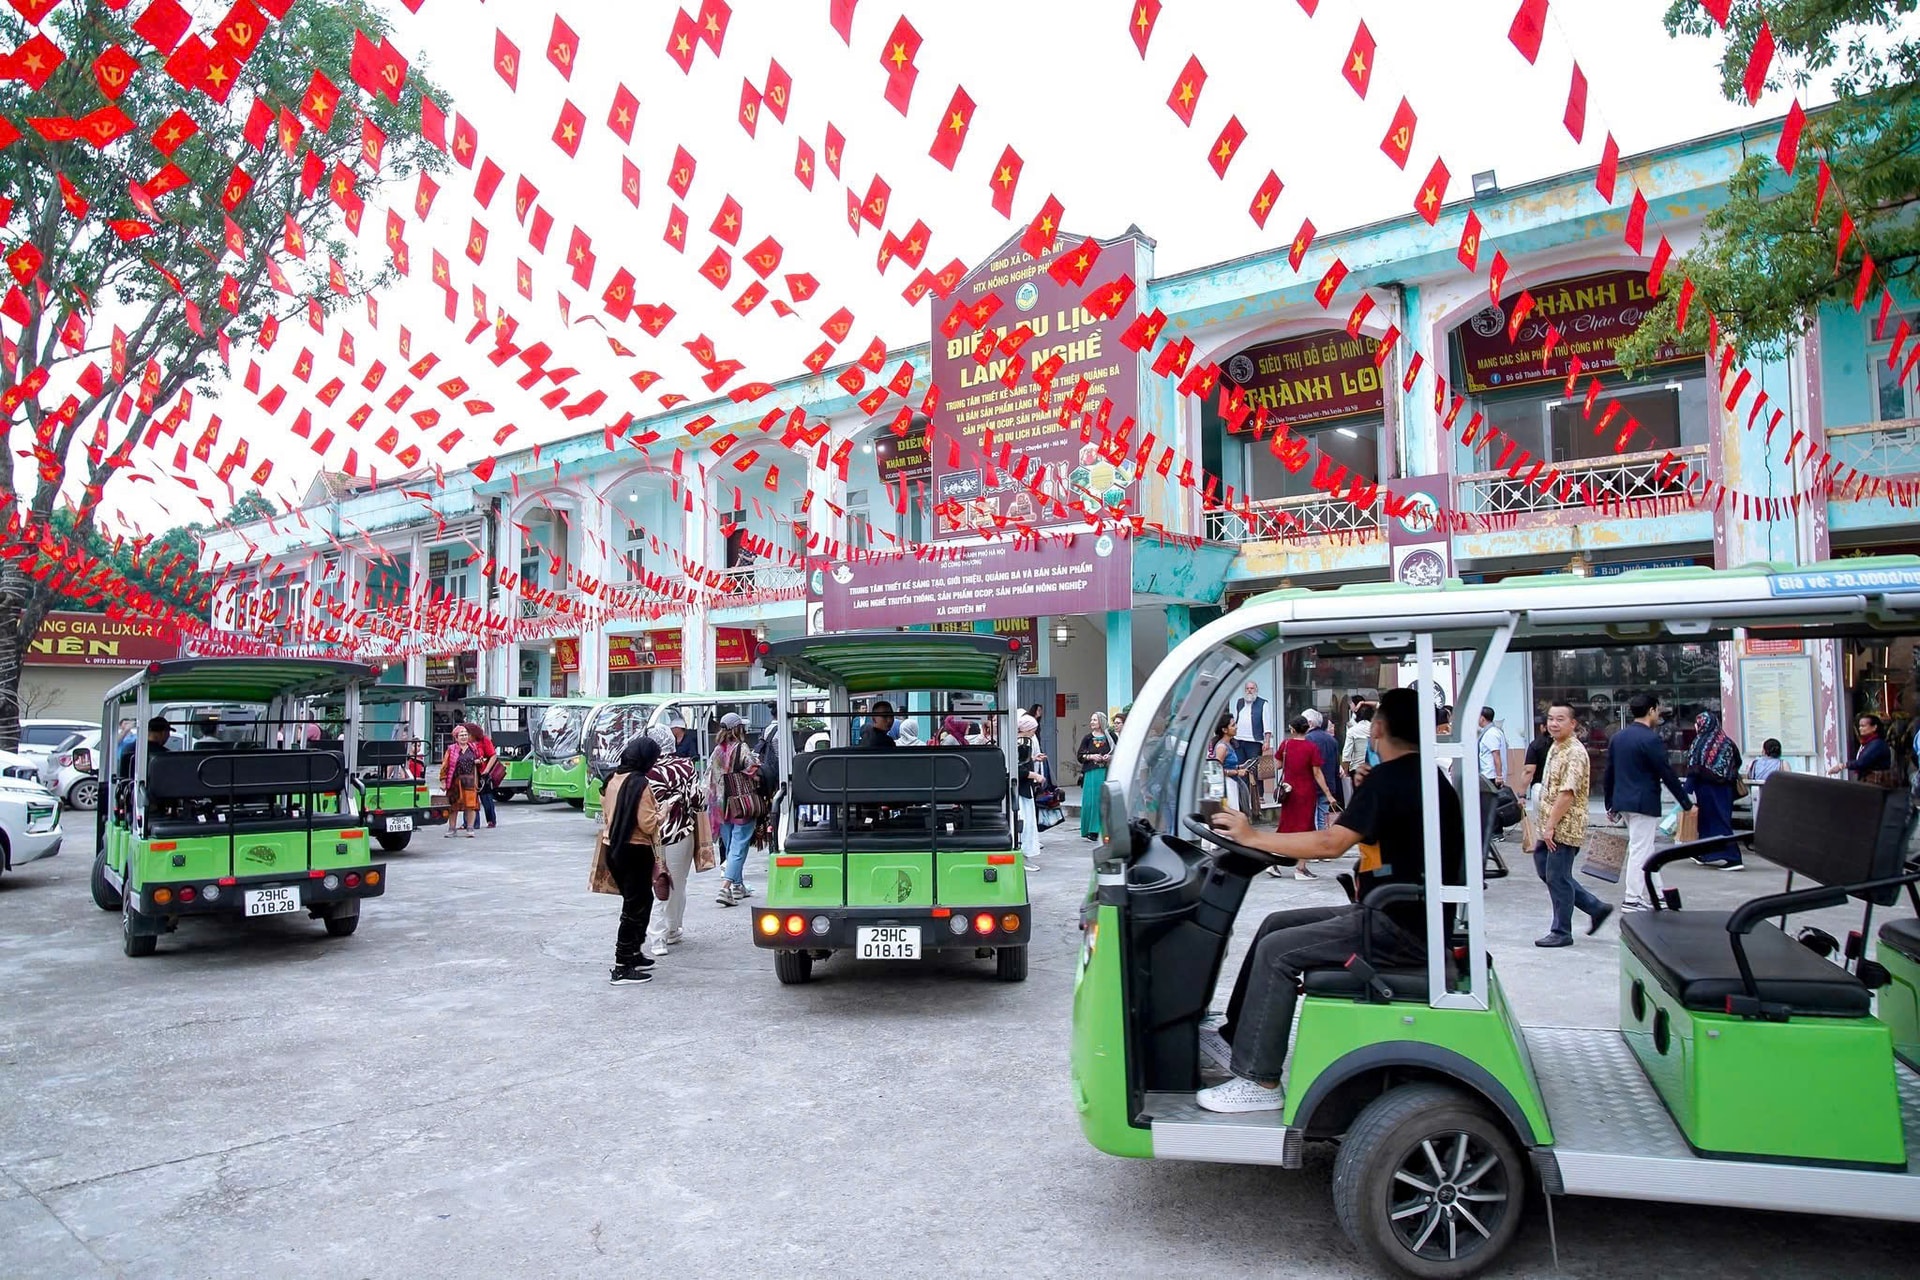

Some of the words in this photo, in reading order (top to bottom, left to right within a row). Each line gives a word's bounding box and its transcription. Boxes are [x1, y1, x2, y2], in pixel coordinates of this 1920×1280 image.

[973, 281, 986, 293] HTX
[987, 275, 1009, 288] NÔNG
[1010, 265, 1036, 281] NGHIỆP
[990, 258, 1009, 272] UBND
[1525, 283, 1617, 320] HÀNH
[1258, 354, 1281, 375] SIÊU
[1283, 351, 1302, 371] THỊ
[1304, 342, 1320, 367] ĐỒ
[1322, 338, 1338, 363] GỖ
[1340, 340, 1363, 359] MINI
[1477, 357, 1498, 369] MANG
[1500, 353, 1514, 366] CÁC
[1515, 350, 1530, 363] SẢN
[1570, 340, 1590, 354] CÔNG
[1244, 375, 1334, 413] THÀNH
[849, 587, 869, 595] TRUNG
[870, 584, 883, 593] TÂM
[884, 581, 901, 592] THIẾT
[912, 578, 930, 589] SÁNG
[985, 571, 1009, 583] QUẢNG
[1011, 569, 1021, 580] BÁ
[1022, 568, 1033, 579] VÀ
[1034, 567, 1050, 578] BÁN
[1051, 565, 1068, 576] SẢN
[1069, 562, 1093, 574] PHẨM
[853, 599, 869, 609] LÀNG
[937, 589, 952, 601] SẢN
[952, 587, 973, 599] PHẨM
[995, 585, 1012, 596] SẢN
[1012, 582, 1034, 595] PHẨM
[1035, 580, 1057, 593] NÔNG
[1058, 579, 1088, 591] NGHIỆP
[71, 622, 97, 634] GIA
[251, 901, 295, 915] 018.28
[257, 888, 289, 902] 29HC
[871, 928, 907, 942] 29HC
[864, 943, 913, 958] 018.15
